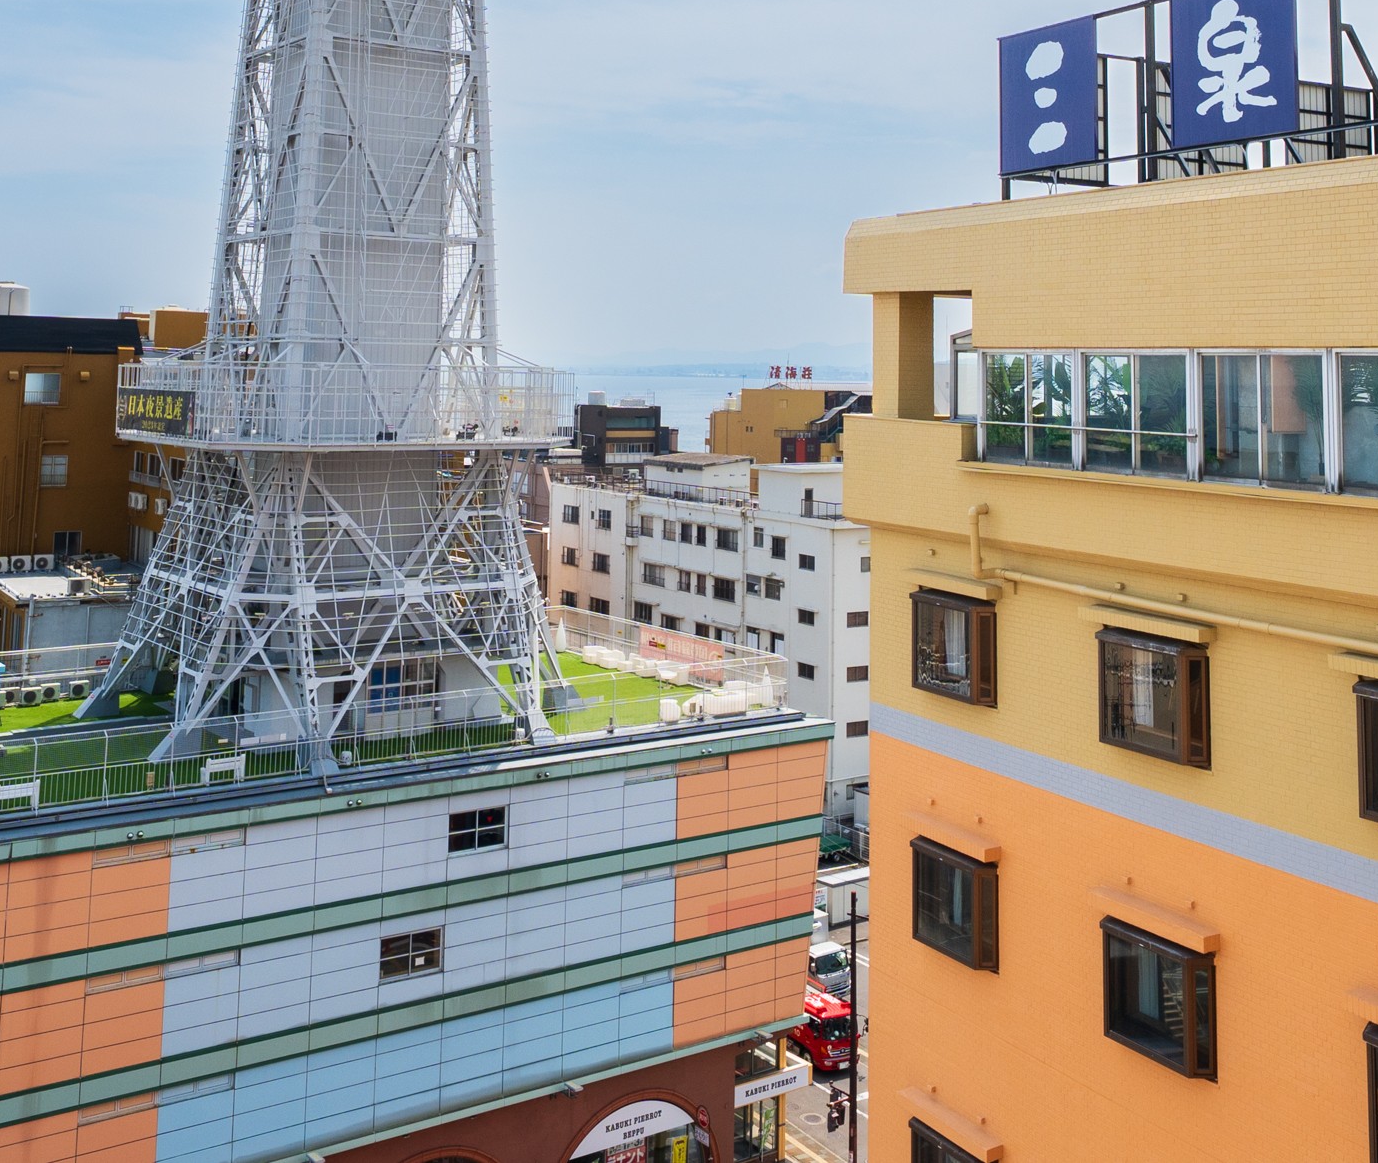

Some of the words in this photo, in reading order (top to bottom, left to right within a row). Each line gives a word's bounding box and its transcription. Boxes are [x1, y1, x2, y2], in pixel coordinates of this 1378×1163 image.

[128, 394, 184, 420] 日本夜景遺産
[745, 1083, 770, 1098] KABUKI
[771, 1076, 797, 1090] PIERROT
[605, 1118, 632, 1133] KABUKI
[633, 1110, 662, 1125] PIERROT
[623, 1127, 645, 1140] BEPPU
